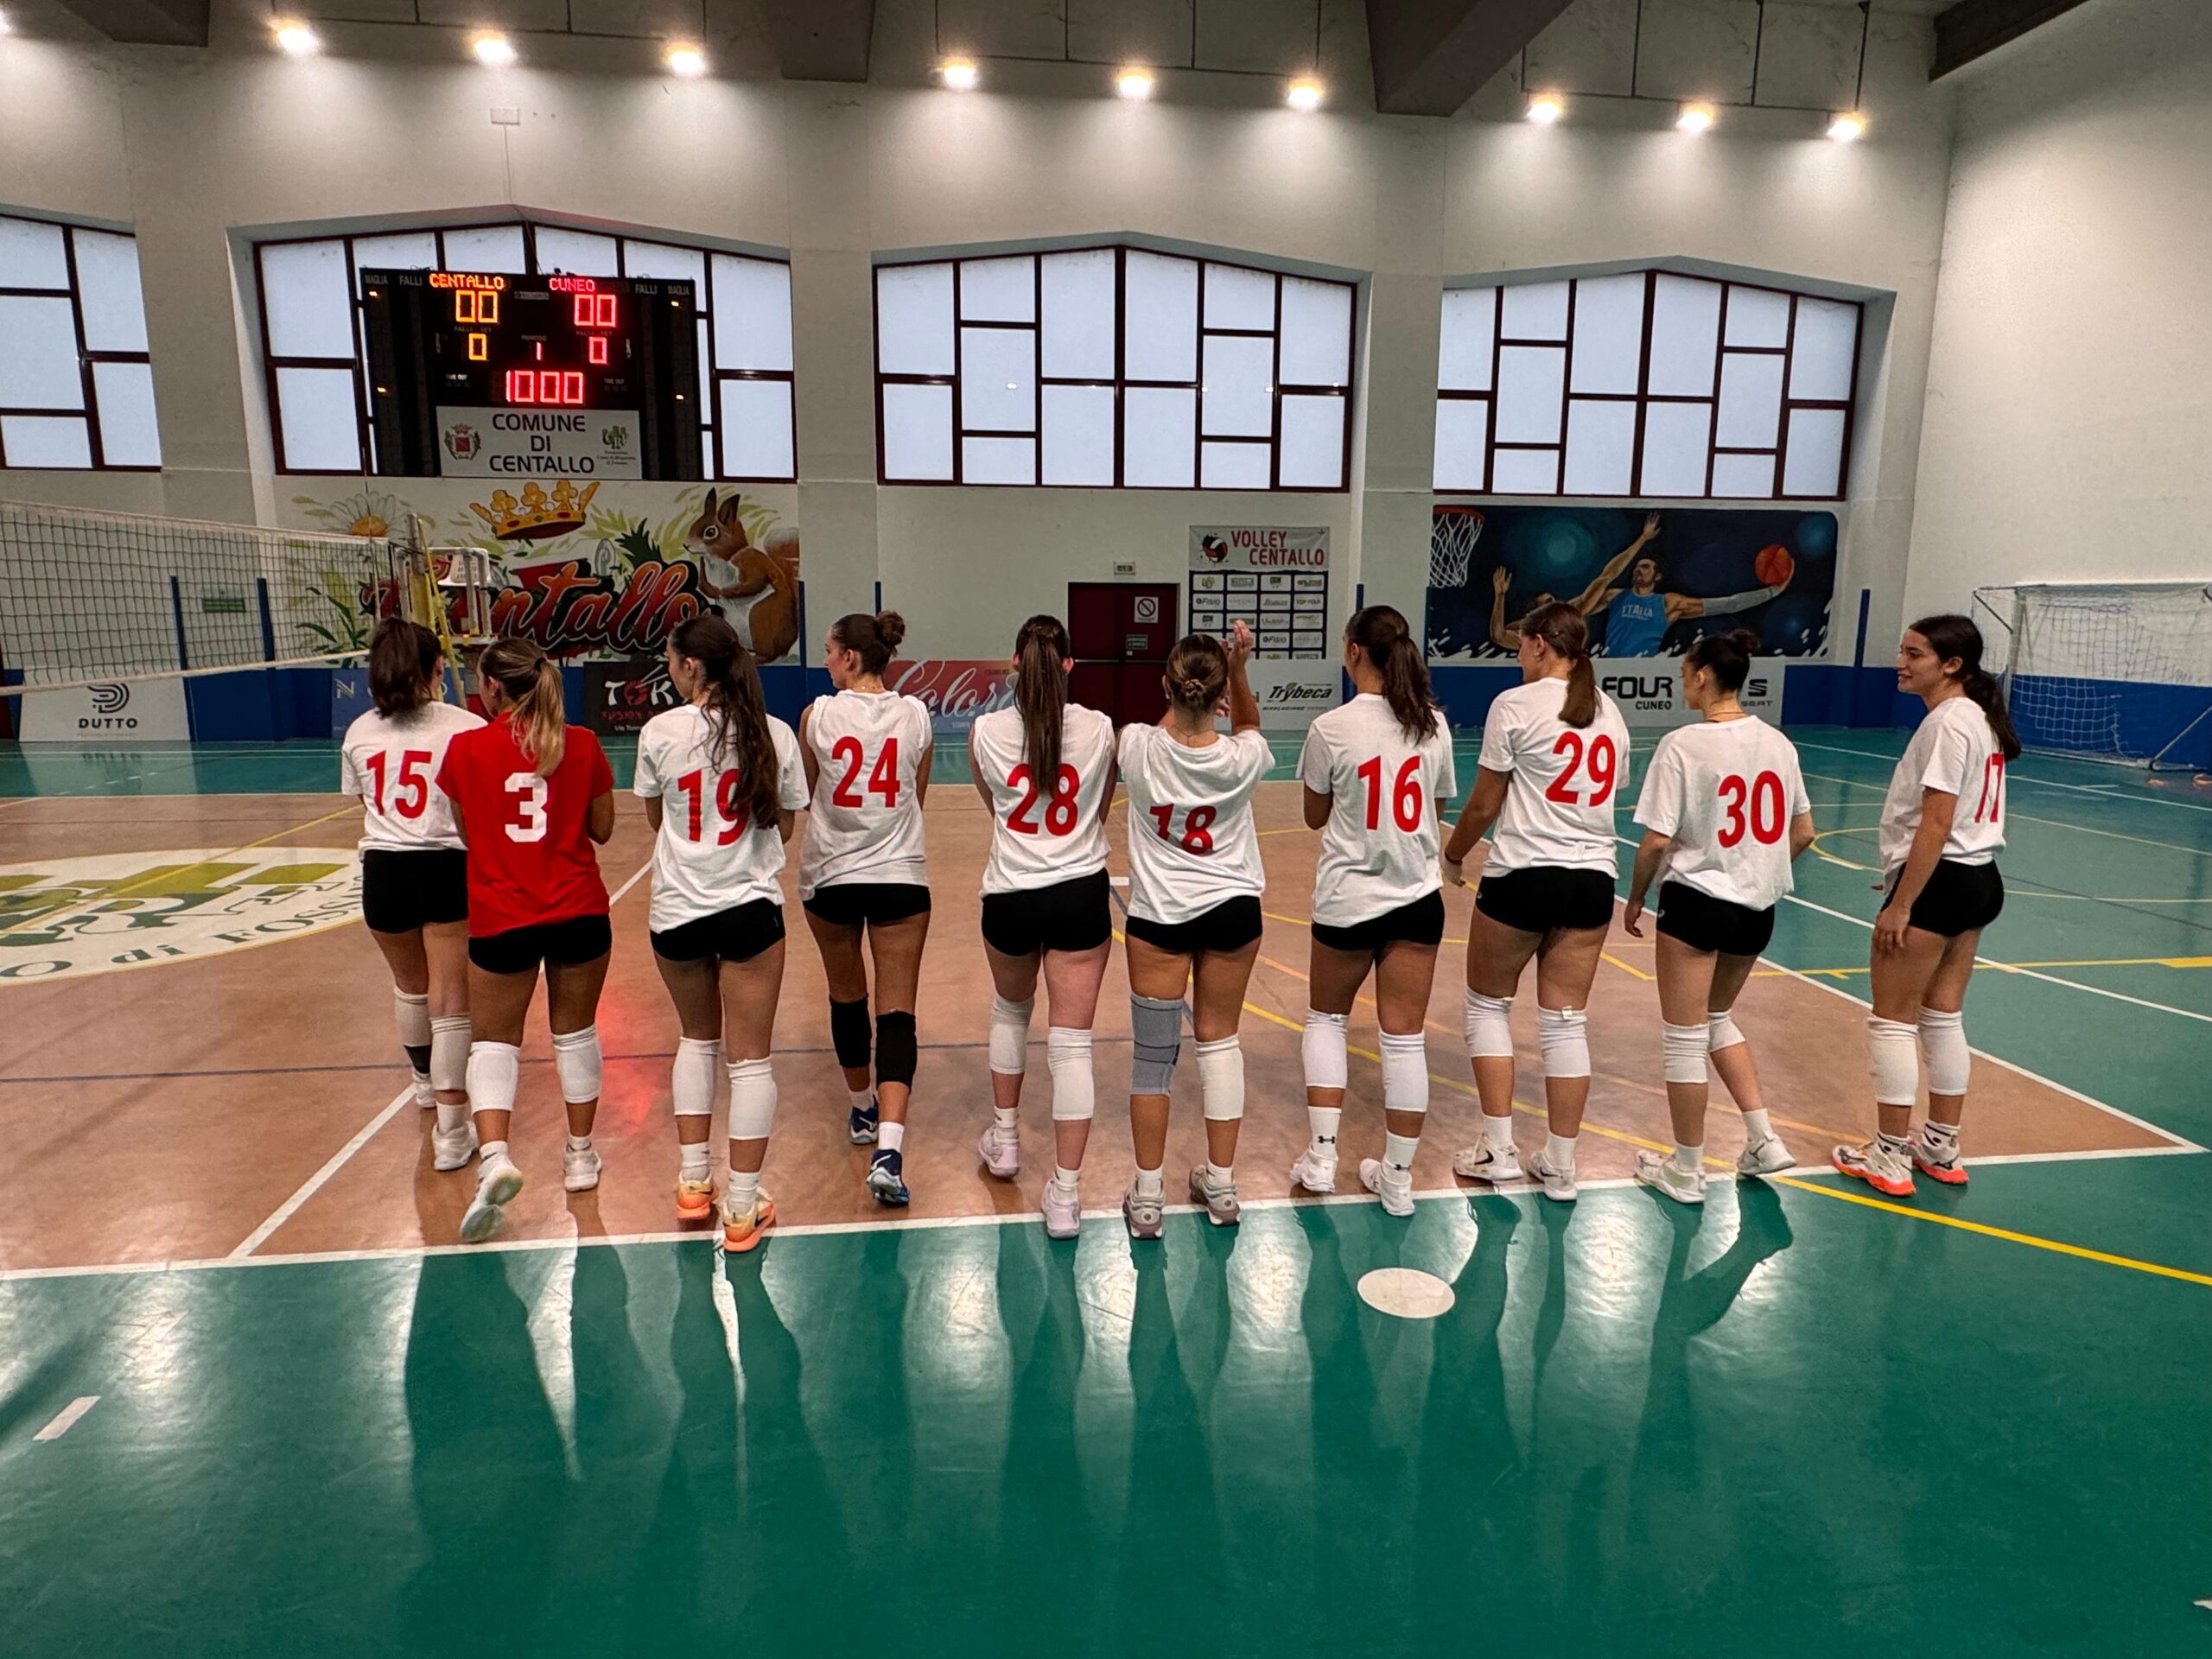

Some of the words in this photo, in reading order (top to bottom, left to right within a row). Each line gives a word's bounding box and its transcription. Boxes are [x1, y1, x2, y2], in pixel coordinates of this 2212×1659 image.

[399, 276, 423, 286] FALLI
[429, 273, 505, 290] CENTALLO
[549, 277, 596, 293] CUNEO
[635, 283, 658, 296] FALLI
[455, 289, 499, 323] 00
[574, 294, 618, 327] 00
[468, 333, 487, 361] 0
[588, 336, 608, 365] 0
[492, 413, 587, 432] COMUNE
[531, 435, 551, 452] DI
[489, 454, 595, 474] CENTALLO
[1230, 530, 1287, 548] VOLLEY
[1249, 548, 1325, 566] CENTALLO
[1622, 605, 1653, 618] ITALIA
[1268, 685, 1333, 702] Trybeca
[1602, 677, 1673, 699] FOUR
[1635, 700, 1672, 710] CUNEO
[78, 717, 138, 729] DUTTO
[831, 735, 901, 809] 24
[1545, 731, 1616, 808] 29
[366, 749, 433, 819] 15
[1357, 755, 1423, 834] 16
[505, 772, 549, 843] 3
[677, 767, 750, 846] 19
[1006, 762, 1081, 837] 28
[1717, 770, 1786, 849] 30
[1149, 803, 1217, 855] 18
[111, 944, 187, 963] di
